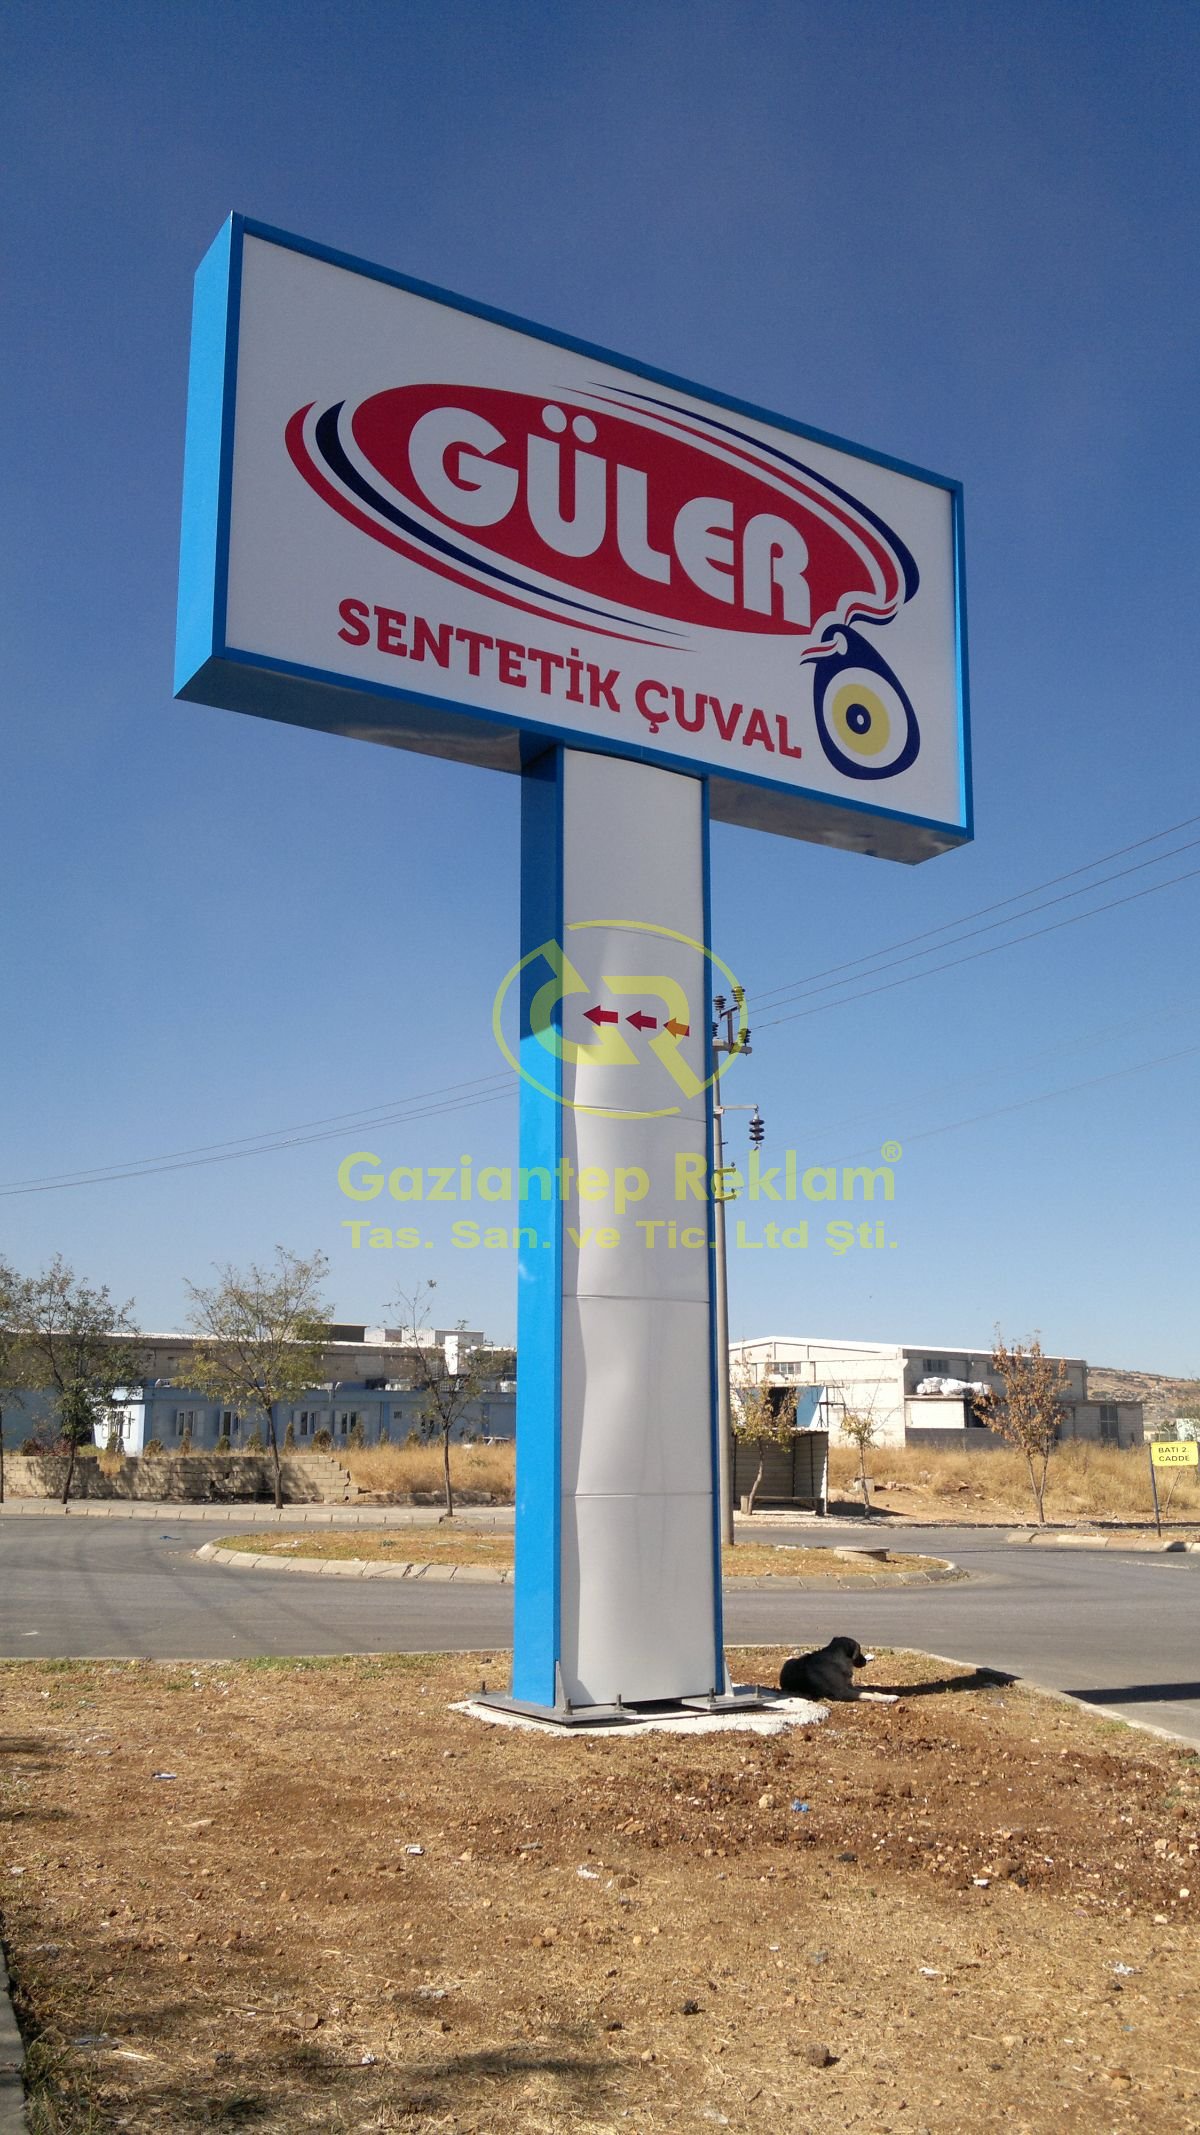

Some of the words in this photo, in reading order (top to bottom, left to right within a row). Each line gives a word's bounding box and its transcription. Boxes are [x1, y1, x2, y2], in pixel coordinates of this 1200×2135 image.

[407, 405, 812, 628] GÜLER
[338, 598, 619, 713] SENTETİK
[635, 680, 802, 759] ÇUVAL
